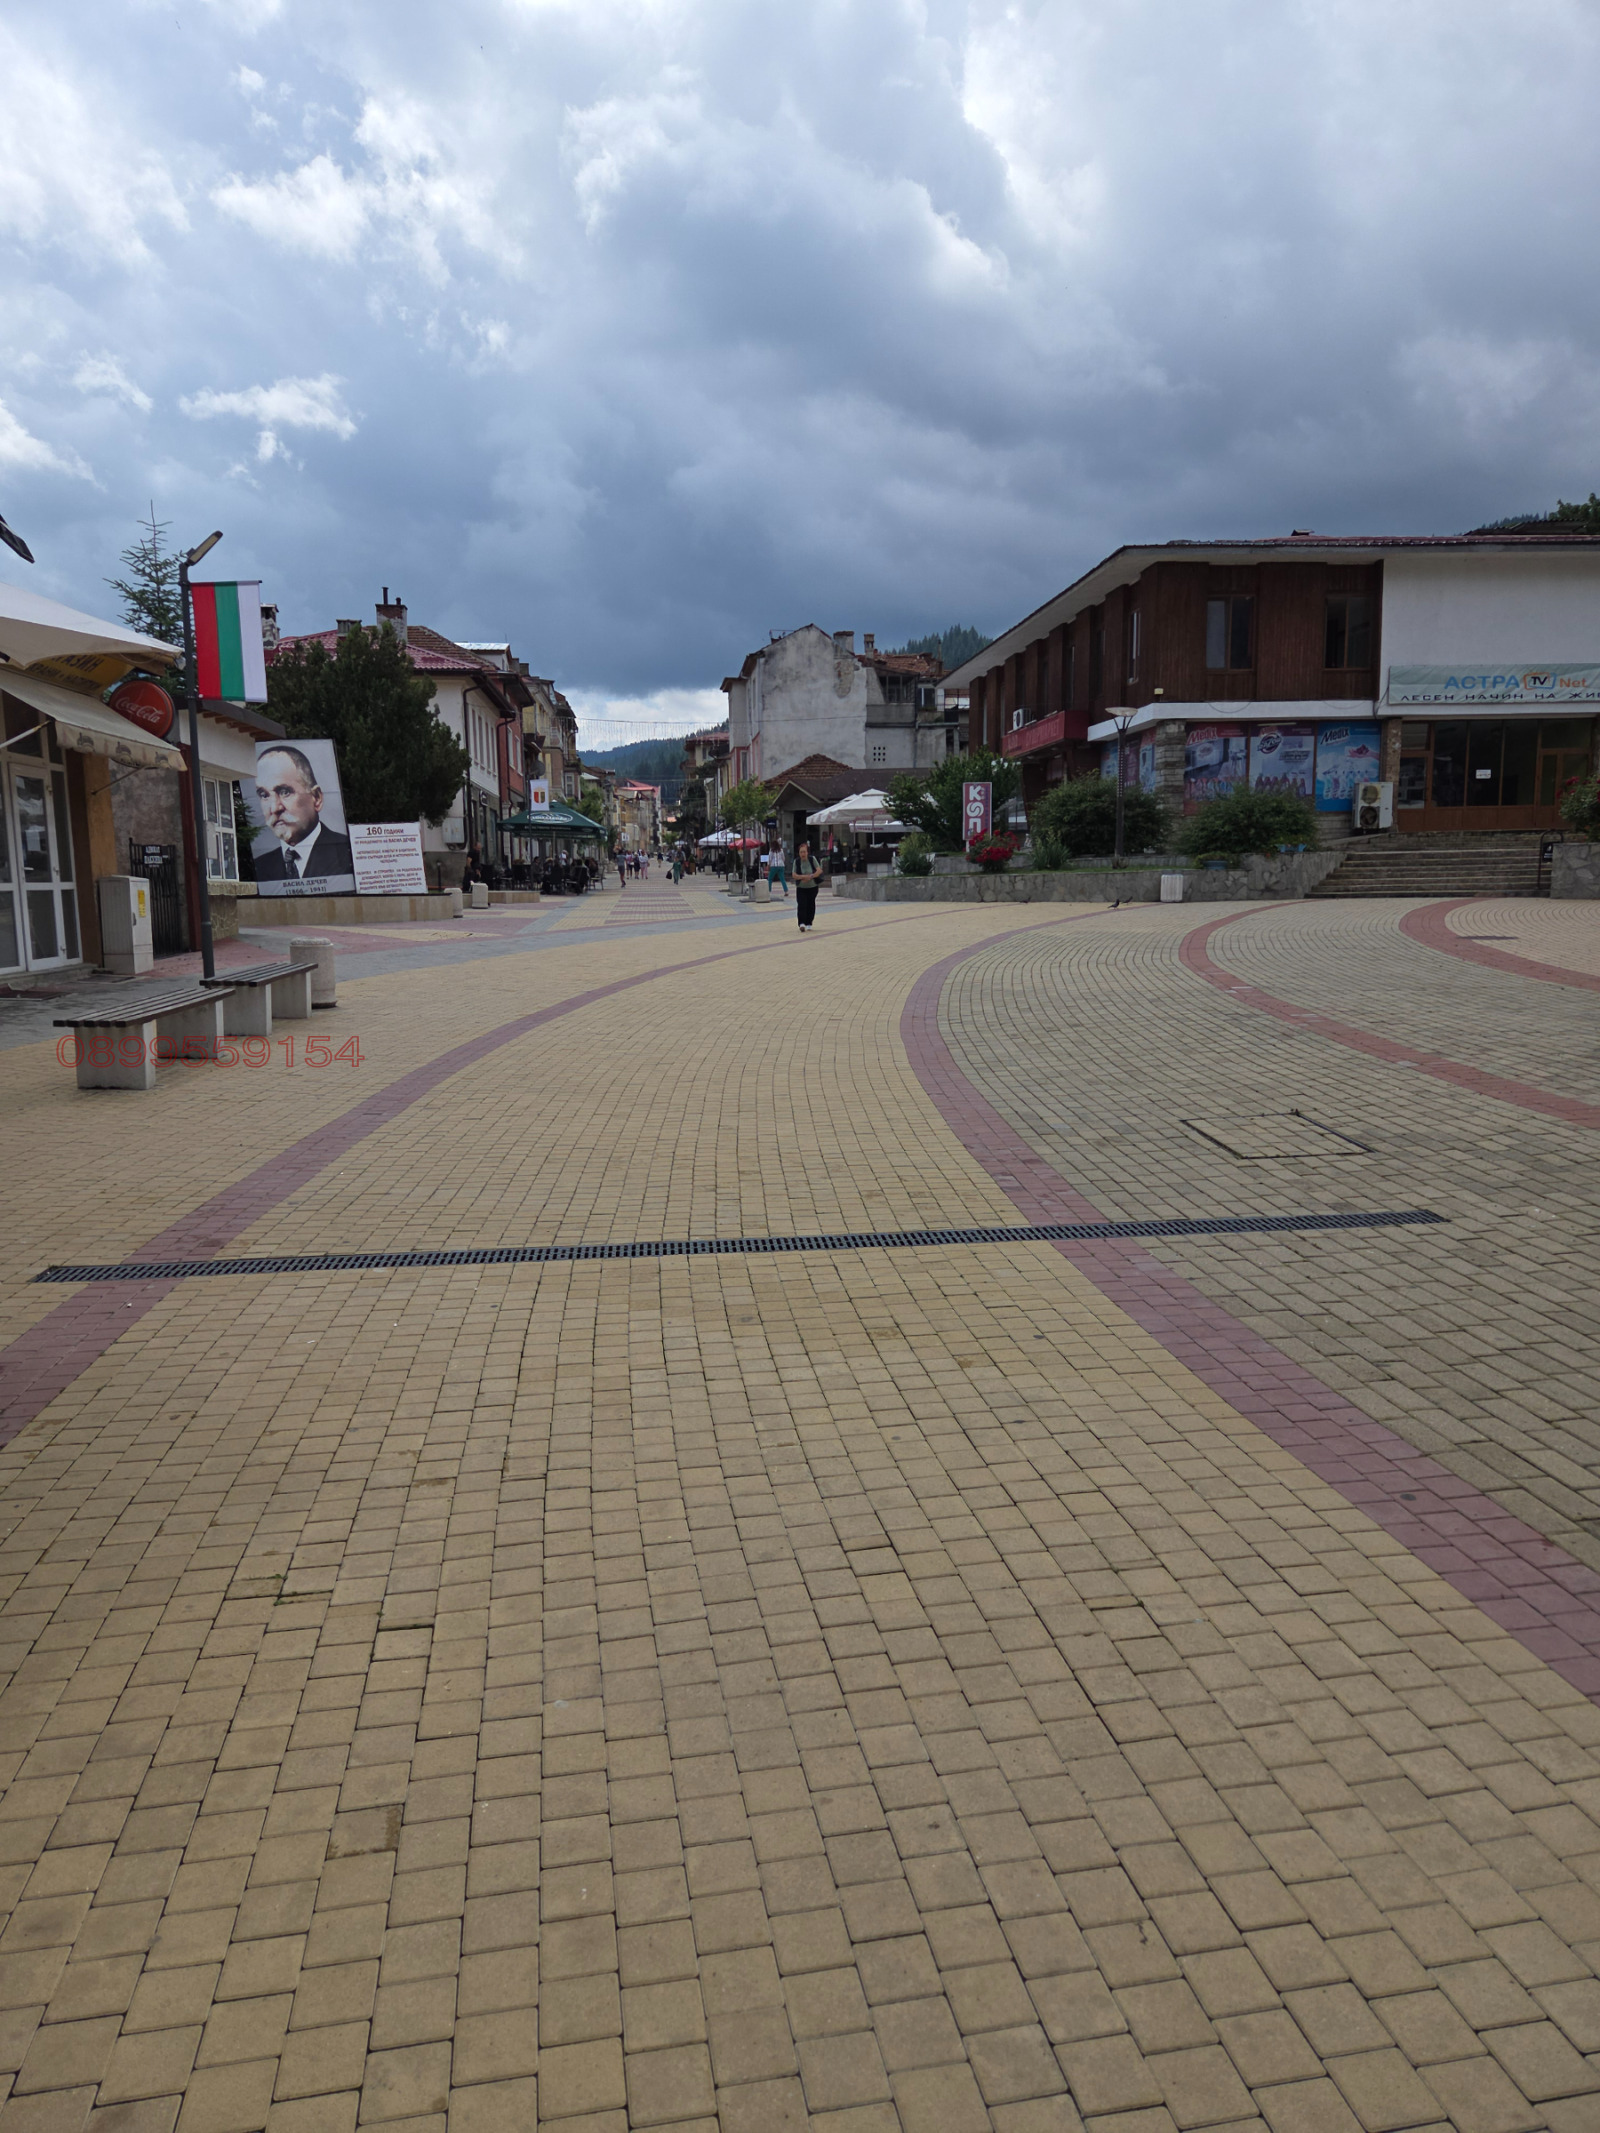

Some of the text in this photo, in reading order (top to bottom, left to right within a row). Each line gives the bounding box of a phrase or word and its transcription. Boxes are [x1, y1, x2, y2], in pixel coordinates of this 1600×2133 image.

[1444, 675, 1520, 690] АСТРА
[1559, 677, 1587, 688] Net
[1186, 727, 1218, 746] Medix
[1320, 727, 1350, 745] Medix
[366, 827, 382, 835] 160
